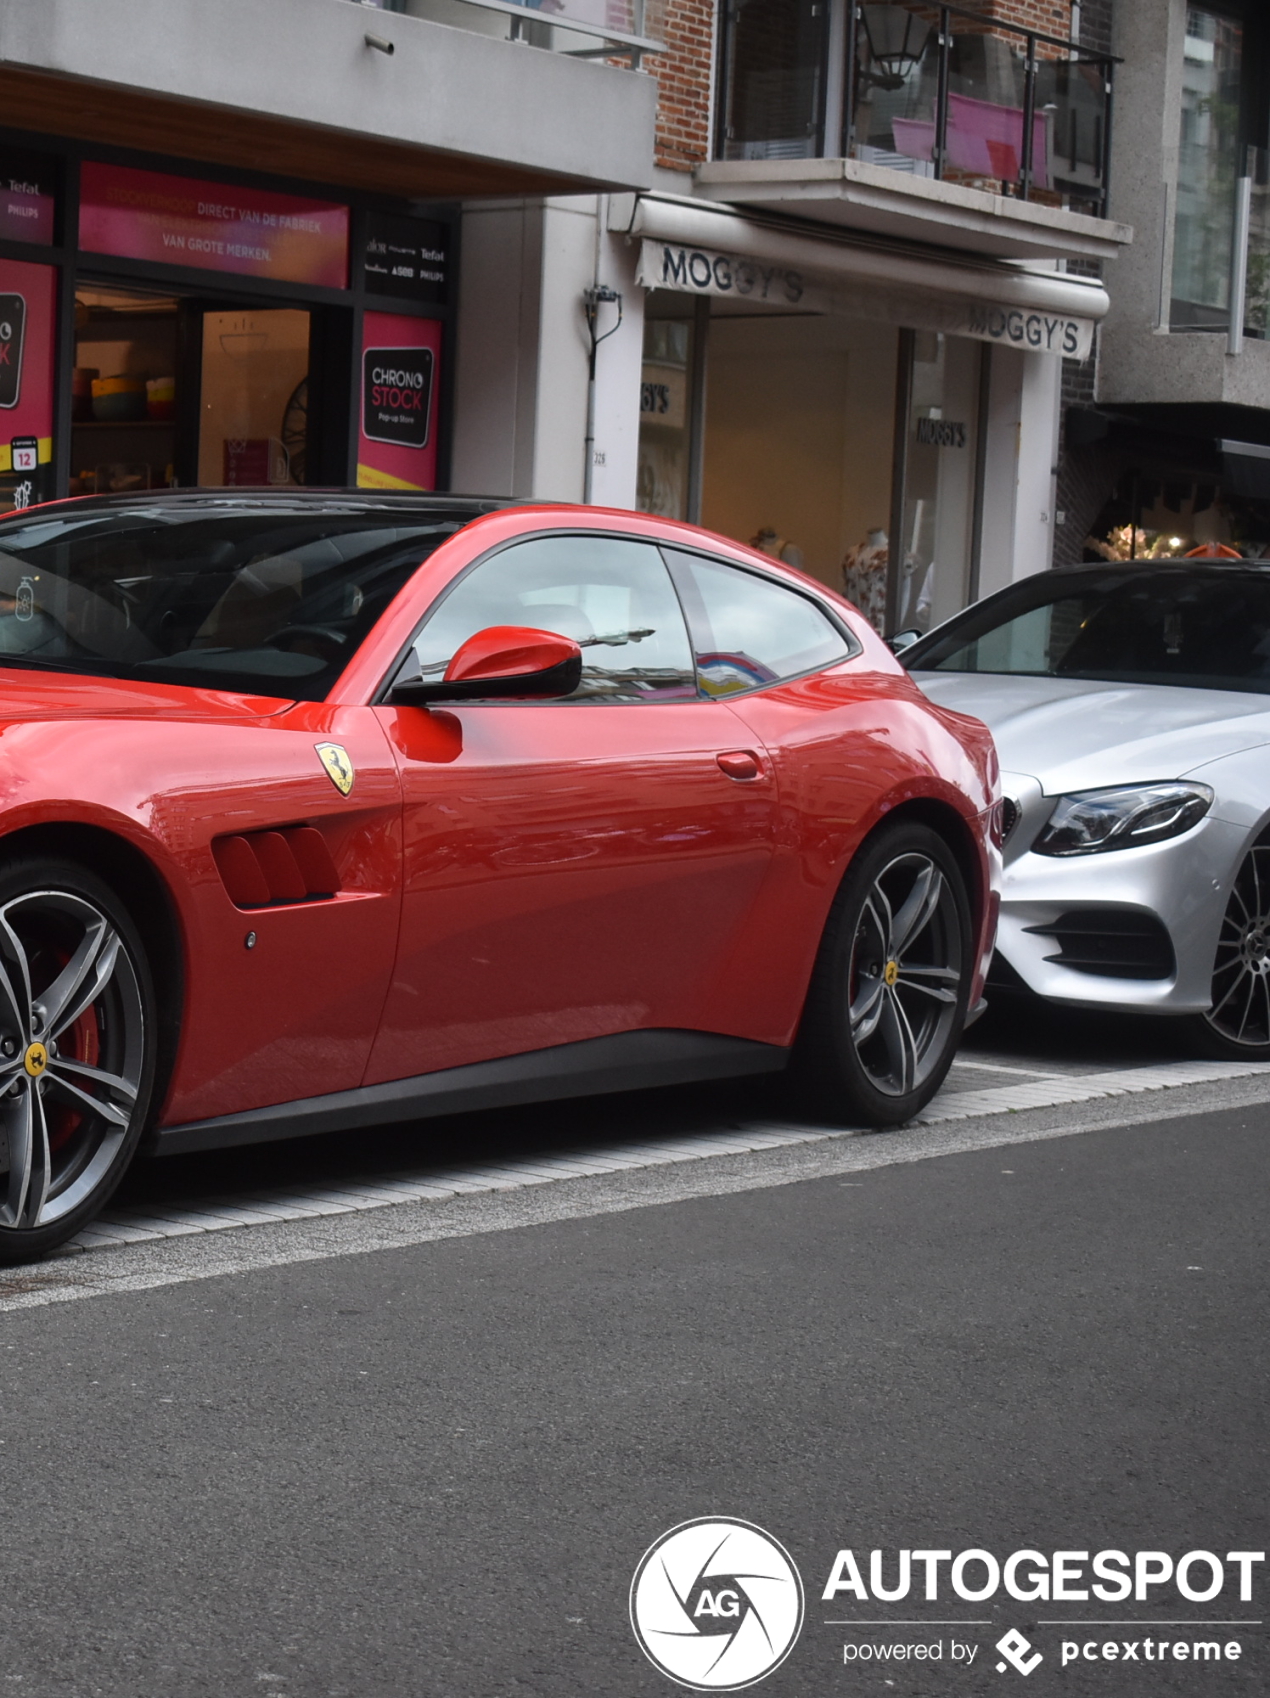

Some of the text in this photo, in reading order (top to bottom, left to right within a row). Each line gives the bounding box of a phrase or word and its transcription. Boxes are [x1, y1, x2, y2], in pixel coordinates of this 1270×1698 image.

[8, 179, 41, 196] Tefal
[8, 204, 39, 219] PHILIPS
[197, 201, 236, 220] DIRECT
[239, 209, 260, 228] VAN
[262, 213, 276, 228] DE
[279, 216, 322, 234] FABRIEK
[162, 232, 272, 263] VAN GROTE MERKEN.
[421, 247, 445, 262] Tefal
[420, 269, 444, 282] PHILIPS
[662, 247, 804, 304] MOGGY'S
[969, 305, 1079, 353] MOGGY'S
[372, 367, 423, 389] CHRONO
[372, 385, 422, 410] STOCK
[18, 452, 31, 467] 12
